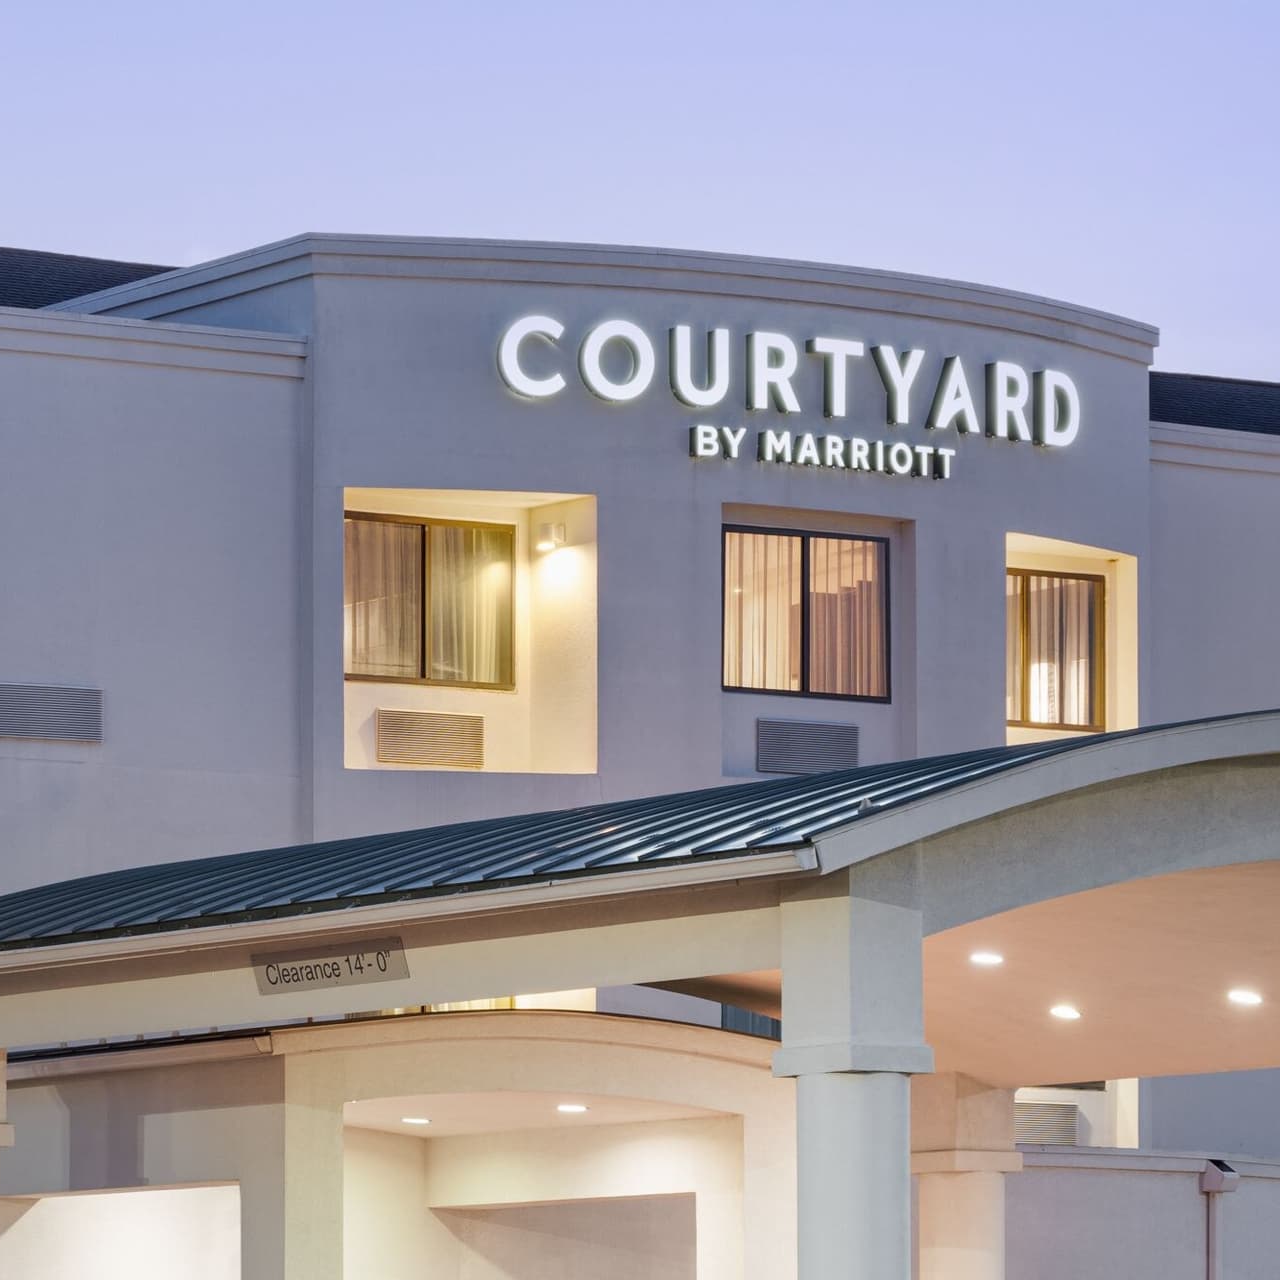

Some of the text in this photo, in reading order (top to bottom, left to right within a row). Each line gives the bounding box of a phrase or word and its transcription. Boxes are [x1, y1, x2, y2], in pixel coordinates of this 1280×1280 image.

[497, 315, 1081, 447] COURTYARD
[692, 424, 956, 479] BY MARRIOTT
[265, 961, 341, 985] Clearance
